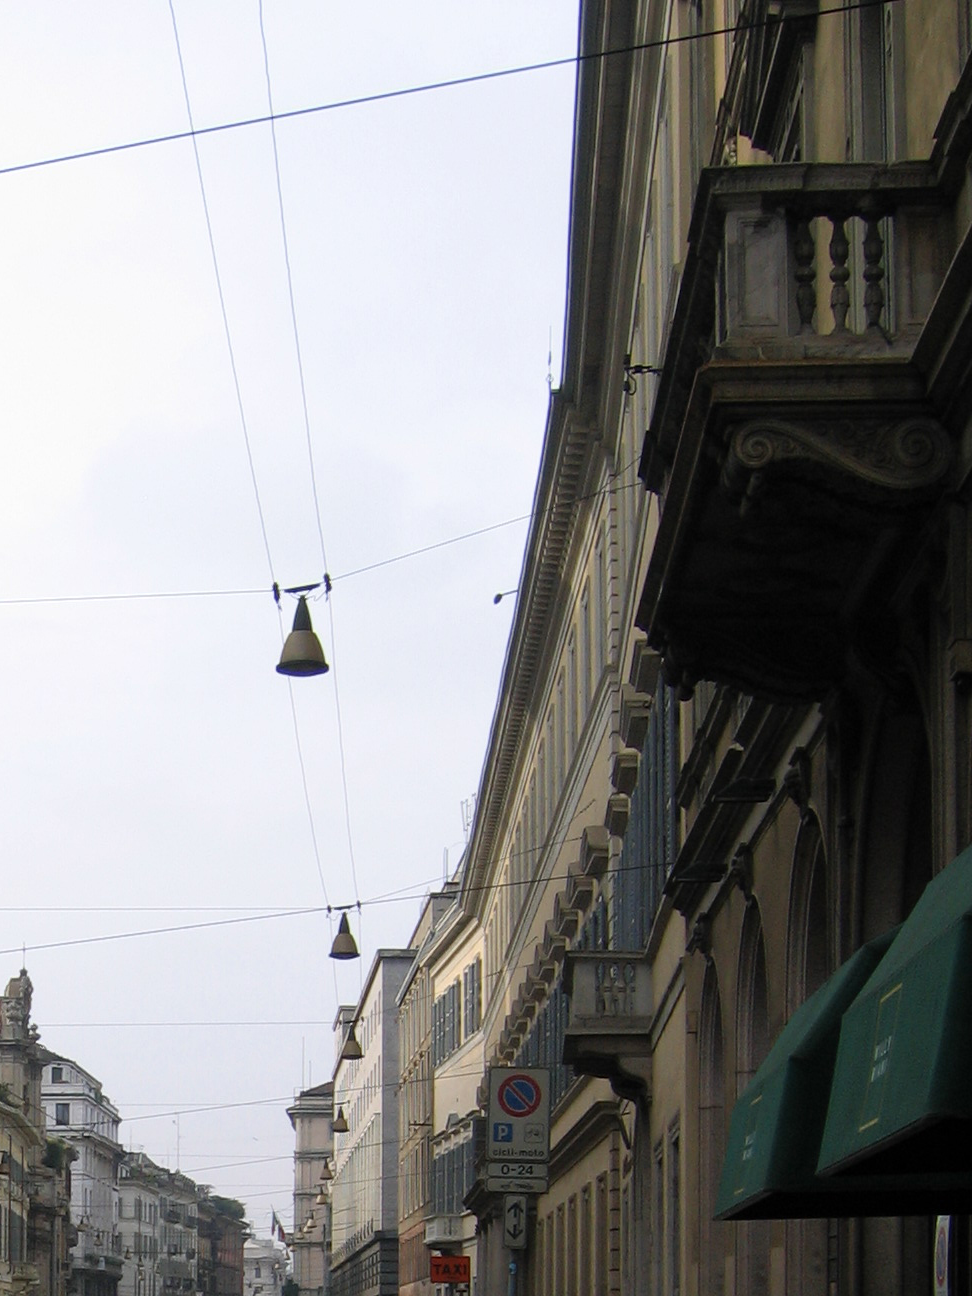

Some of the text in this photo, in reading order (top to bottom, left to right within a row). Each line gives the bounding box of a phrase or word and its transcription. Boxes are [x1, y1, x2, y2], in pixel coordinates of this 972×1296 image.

[499, 1126, 508, 1141] P
[493, 1148, 545, 1157] cicli-moto
[501, 1164, 534, 1176] 0-24
[433, 1264, 468, 1275] TAXI
